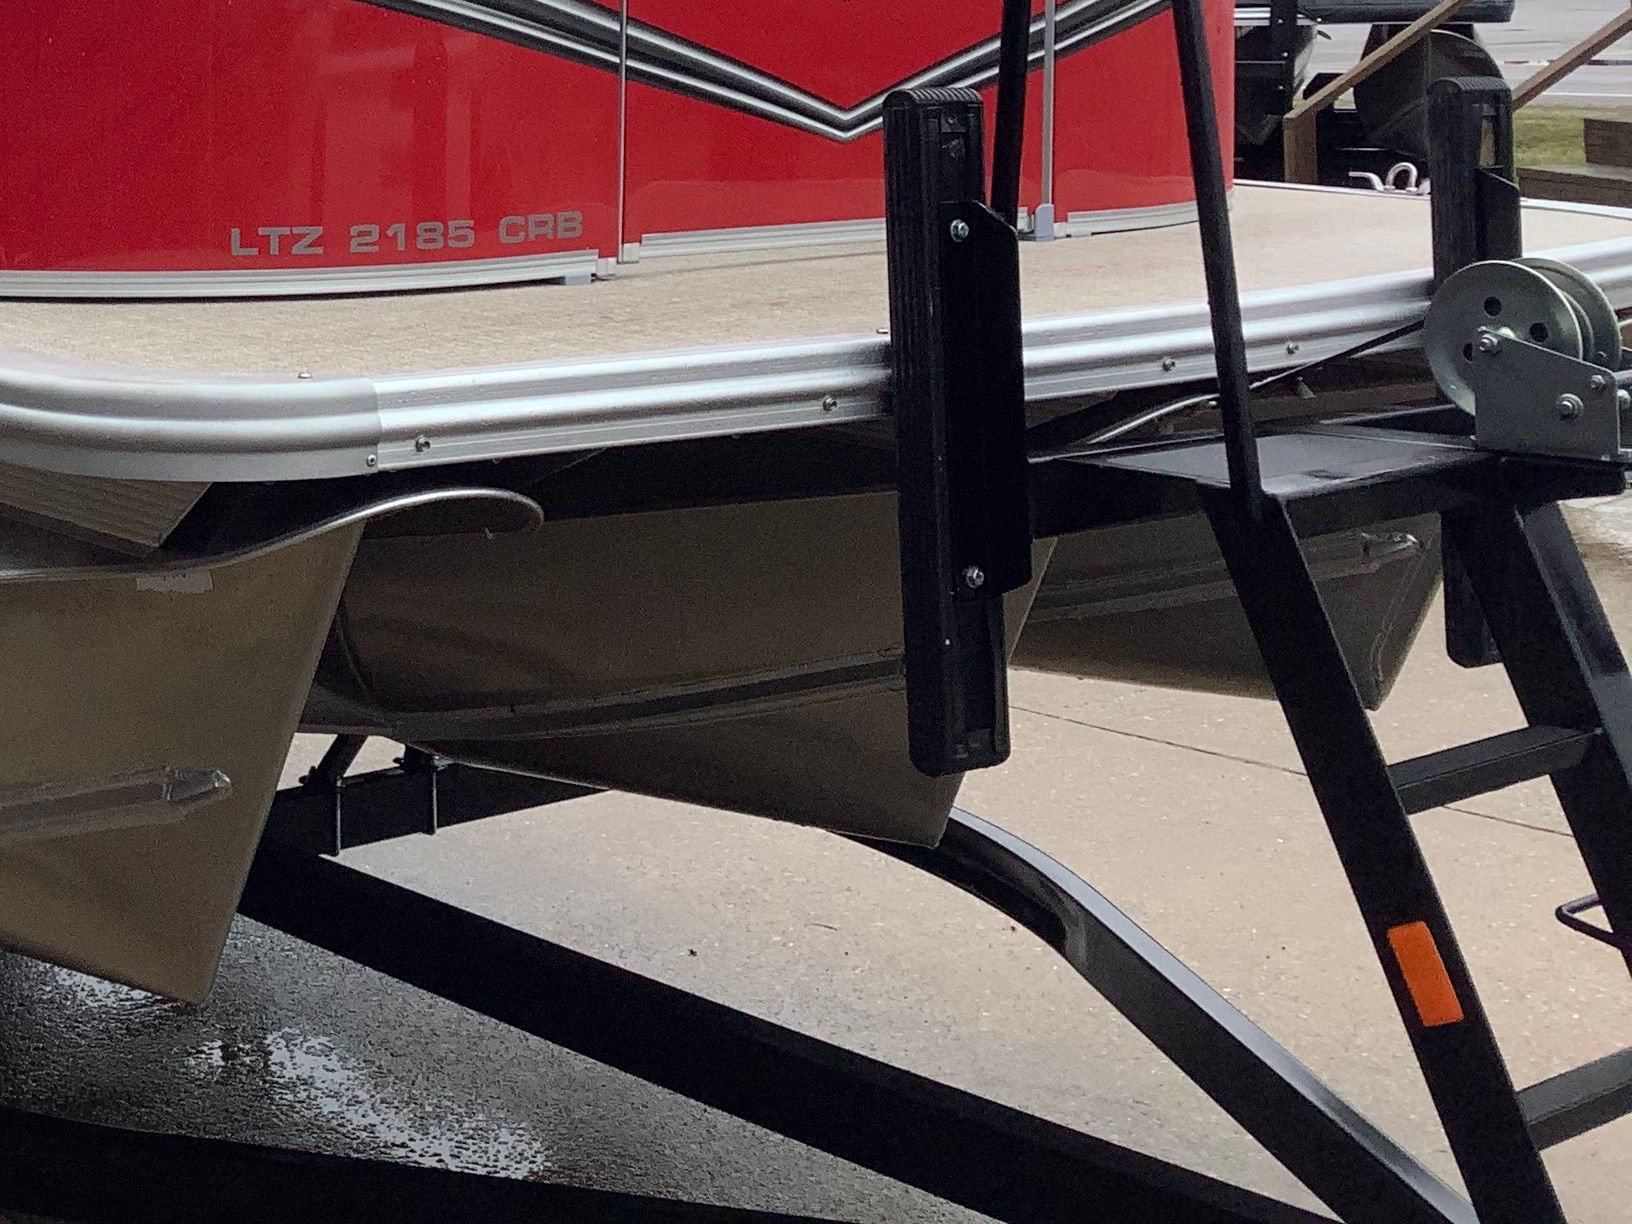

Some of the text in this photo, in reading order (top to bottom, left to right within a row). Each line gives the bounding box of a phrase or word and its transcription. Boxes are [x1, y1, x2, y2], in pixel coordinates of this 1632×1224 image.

[230, 210, 584, 256] LTZ 2185 CRB
